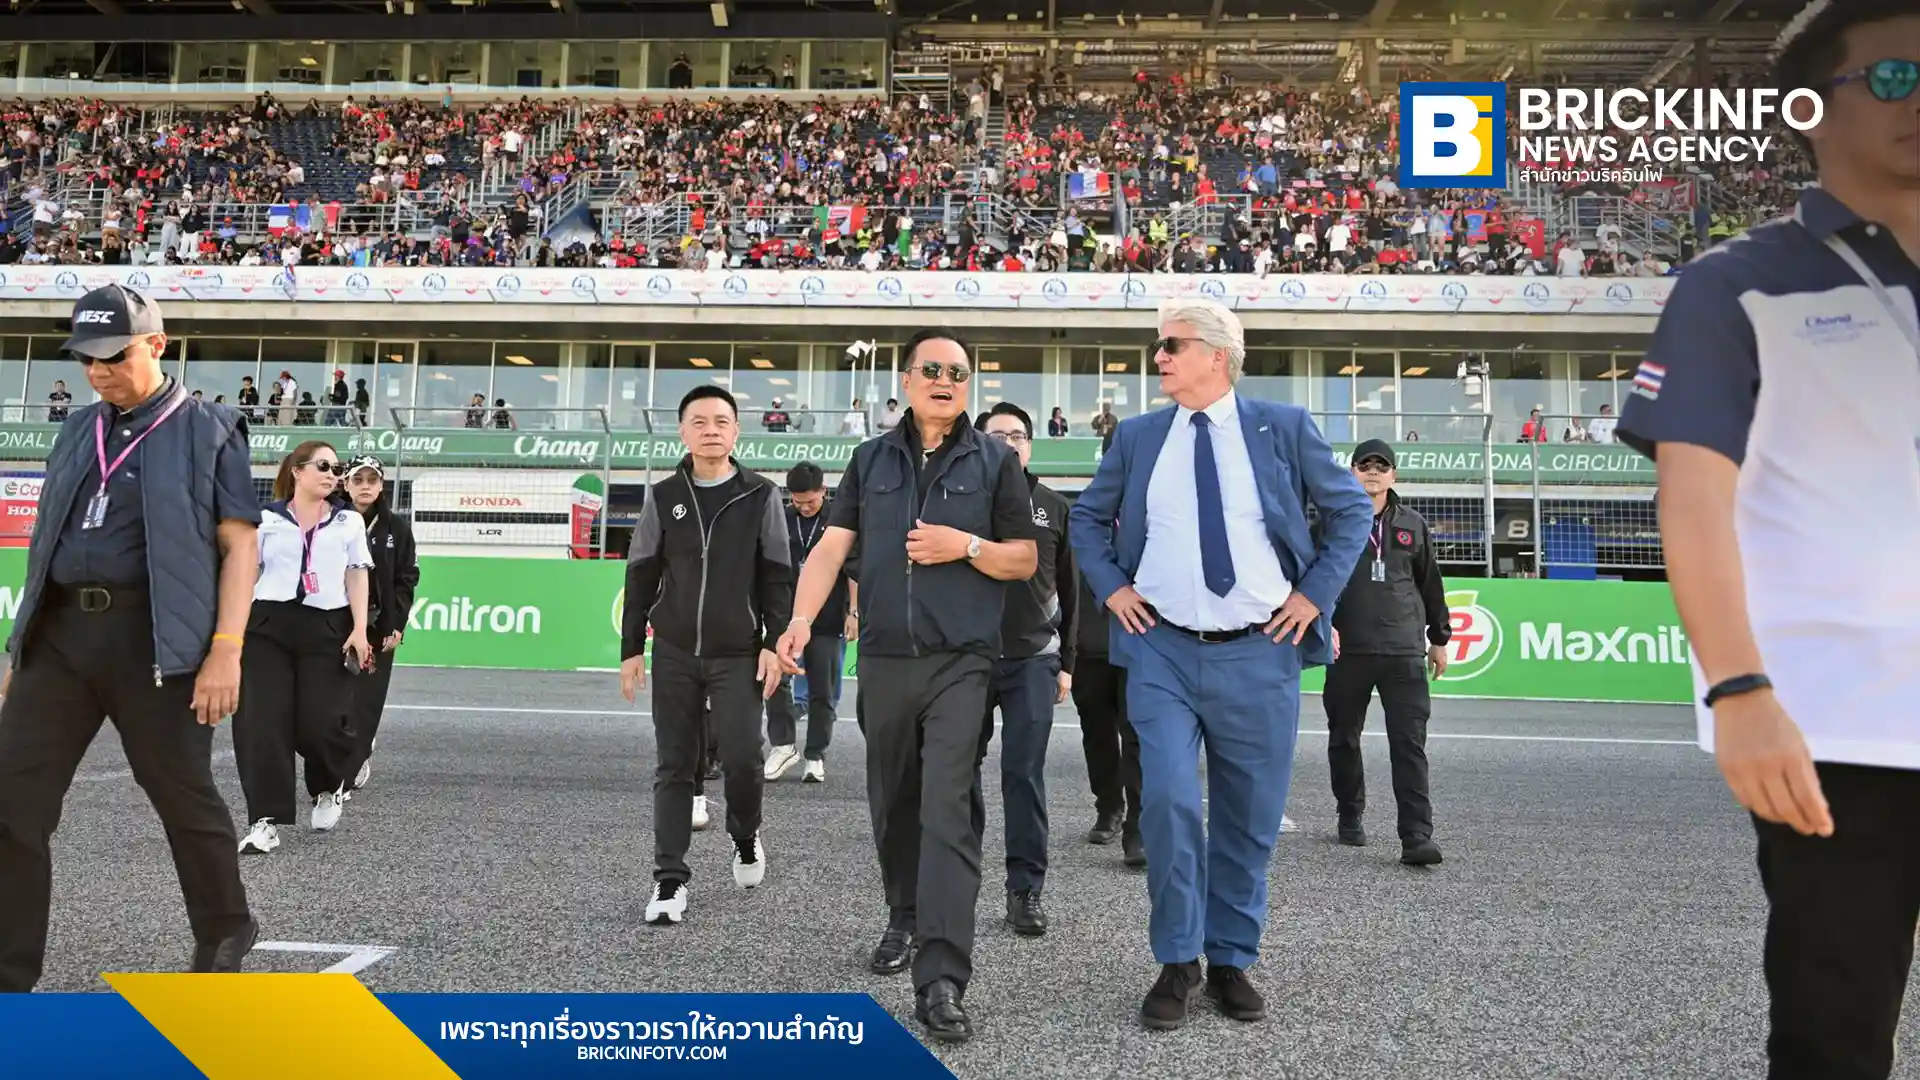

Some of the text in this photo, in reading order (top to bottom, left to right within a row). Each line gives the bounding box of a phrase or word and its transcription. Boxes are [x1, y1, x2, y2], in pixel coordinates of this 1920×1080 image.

[248, 434, 289, 452] ang
[514, 435, 599, 463] Chang
[772, 443, 858, 460] CIRCUIT
[1552, 453, 1643, 471] CIRCUIT
[459, 497, 523, 506] HONDA
[407, 595, 541, 634] xnitron
[1519, 621, 1692, 664] Maxnit
